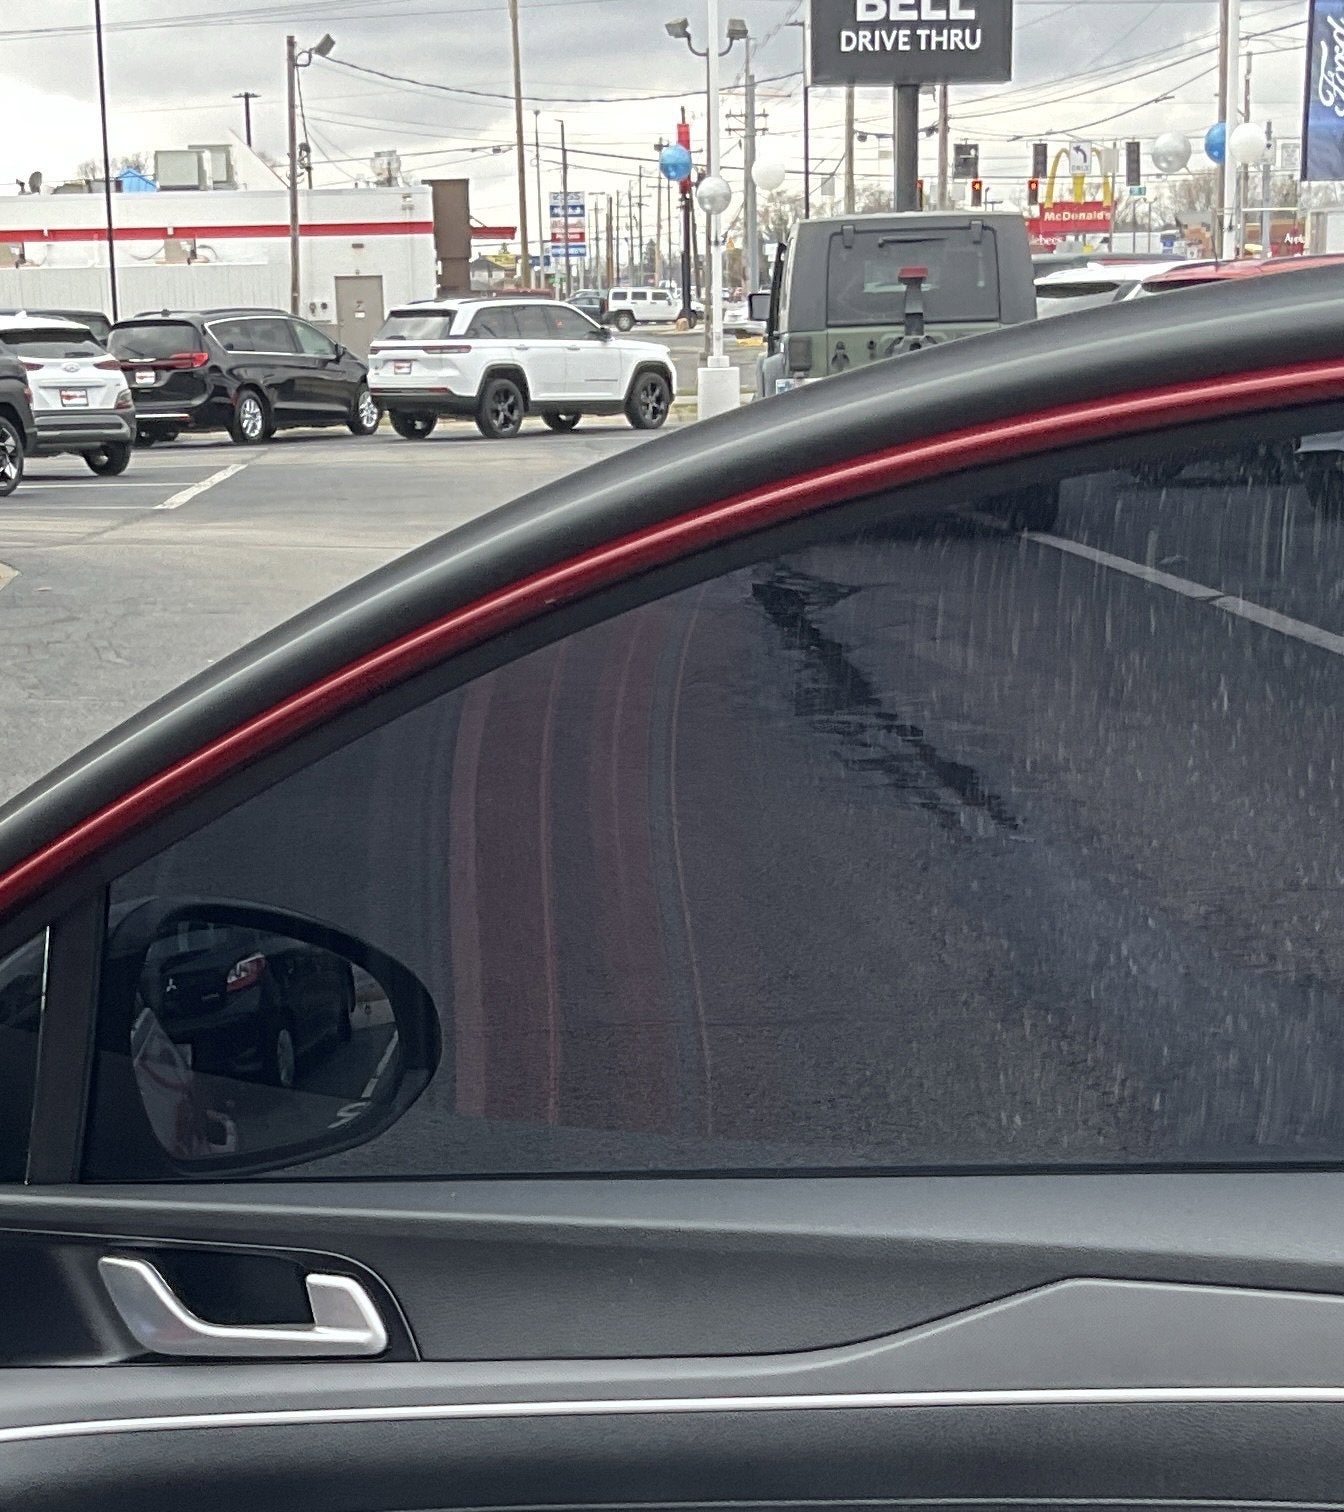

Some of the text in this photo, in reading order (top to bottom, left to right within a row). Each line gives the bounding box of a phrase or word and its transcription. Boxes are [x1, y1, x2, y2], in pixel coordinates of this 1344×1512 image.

[856, 0, 976, 21] BELL
[840, 29, 982, 51] DRIVE THRU
[1044, 211, 1111, 222] McDonald's
